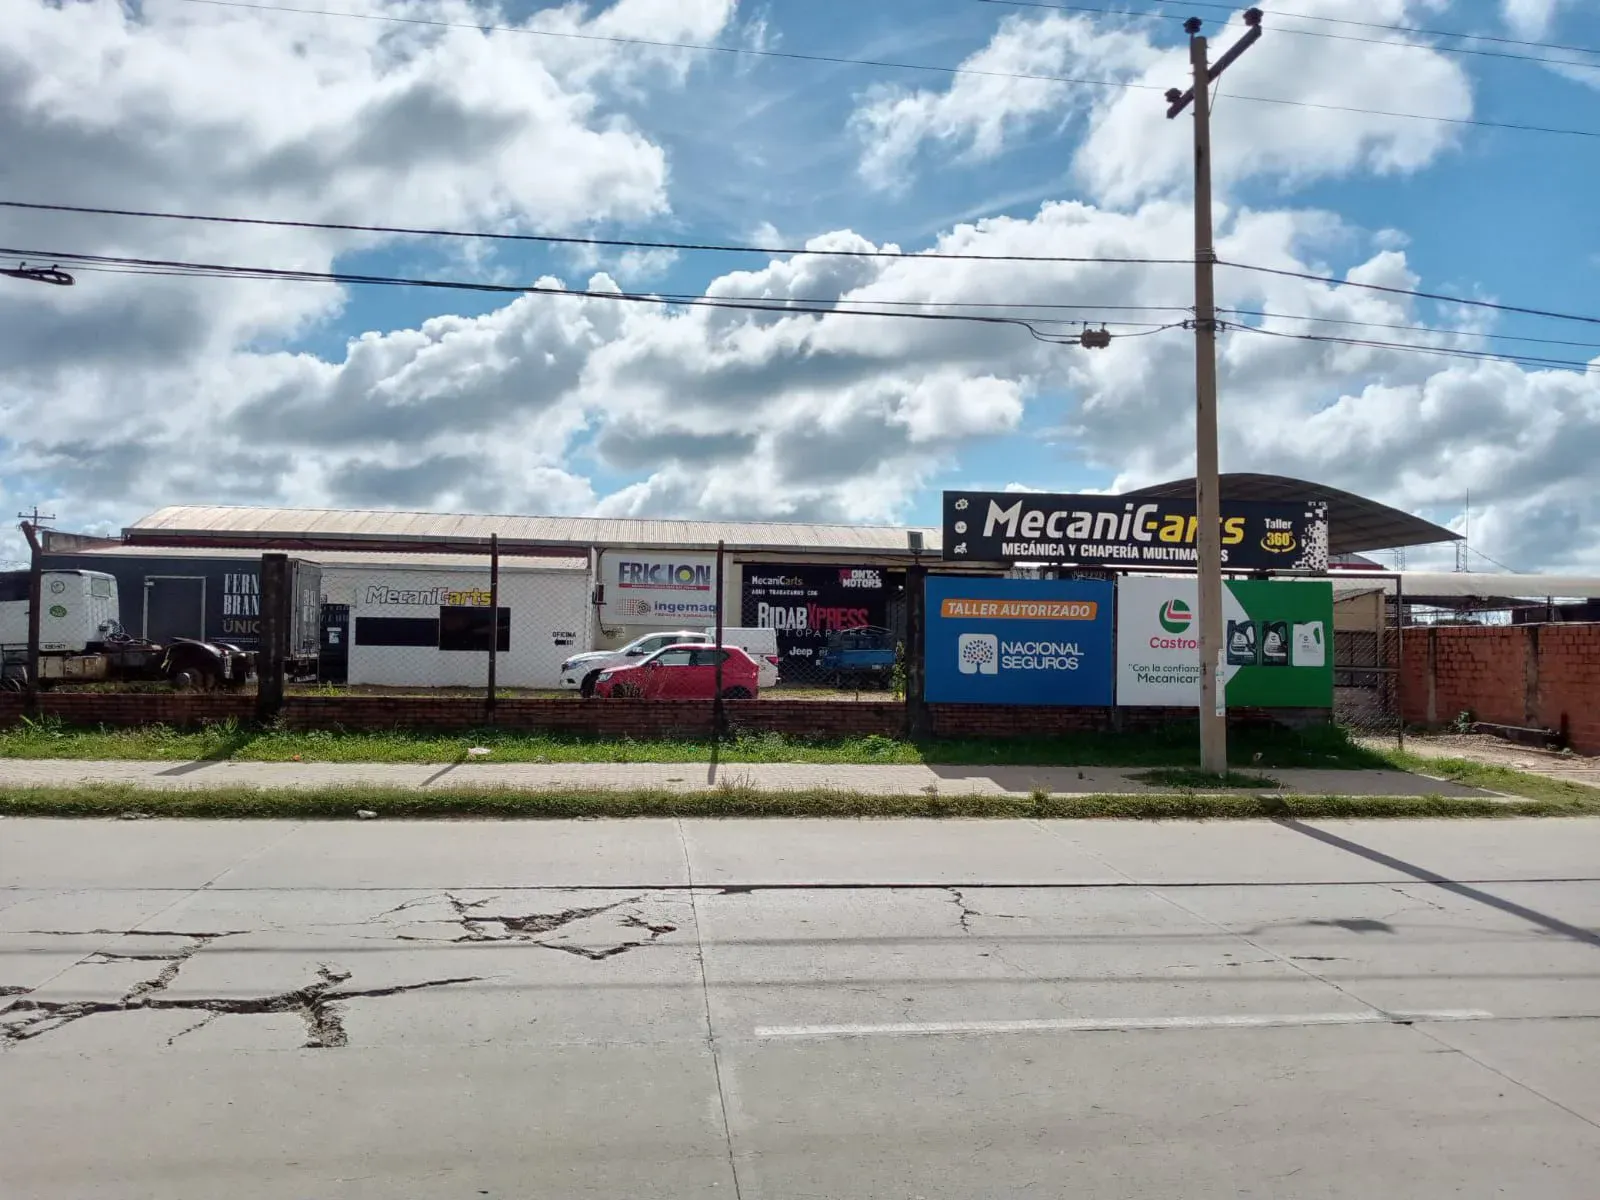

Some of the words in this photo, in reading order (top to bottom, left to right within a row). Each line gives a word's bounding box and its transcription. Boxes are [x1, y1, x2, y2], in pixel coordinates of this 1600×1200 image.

[1264, 518, 1293, 529] Taller
[1002, 540, 1065, 557] MECÁNICA
[1068, 544, 1077, 557] Y
[1080, 543, 1139, 559] CHAPERÍA
[1143, 547, 1229, 562] MULTIMAS
[223, 573, 260, 594] FERN
[842, 579, 882, 588] MOTORS
[223, 594, 260, 616] BRAN
[948, 603, 997, 615] TALLER
[1000, 604, 1090, 617] AUTORIZADO
[223, 618, 260, 634] ÚNIC
[1001, 642, 1084, 656] NACIONAL
[1149, 637, 1200, 649] Castro
[789, 646, 813, 657] Jeep
[1002, 656, 1079, 670] SEGUROS
[1152, 663, 1160, 673] la
[1163, 663, 1200, 673] confianz
[1137, 673, 1200, 683] Mecanicar
